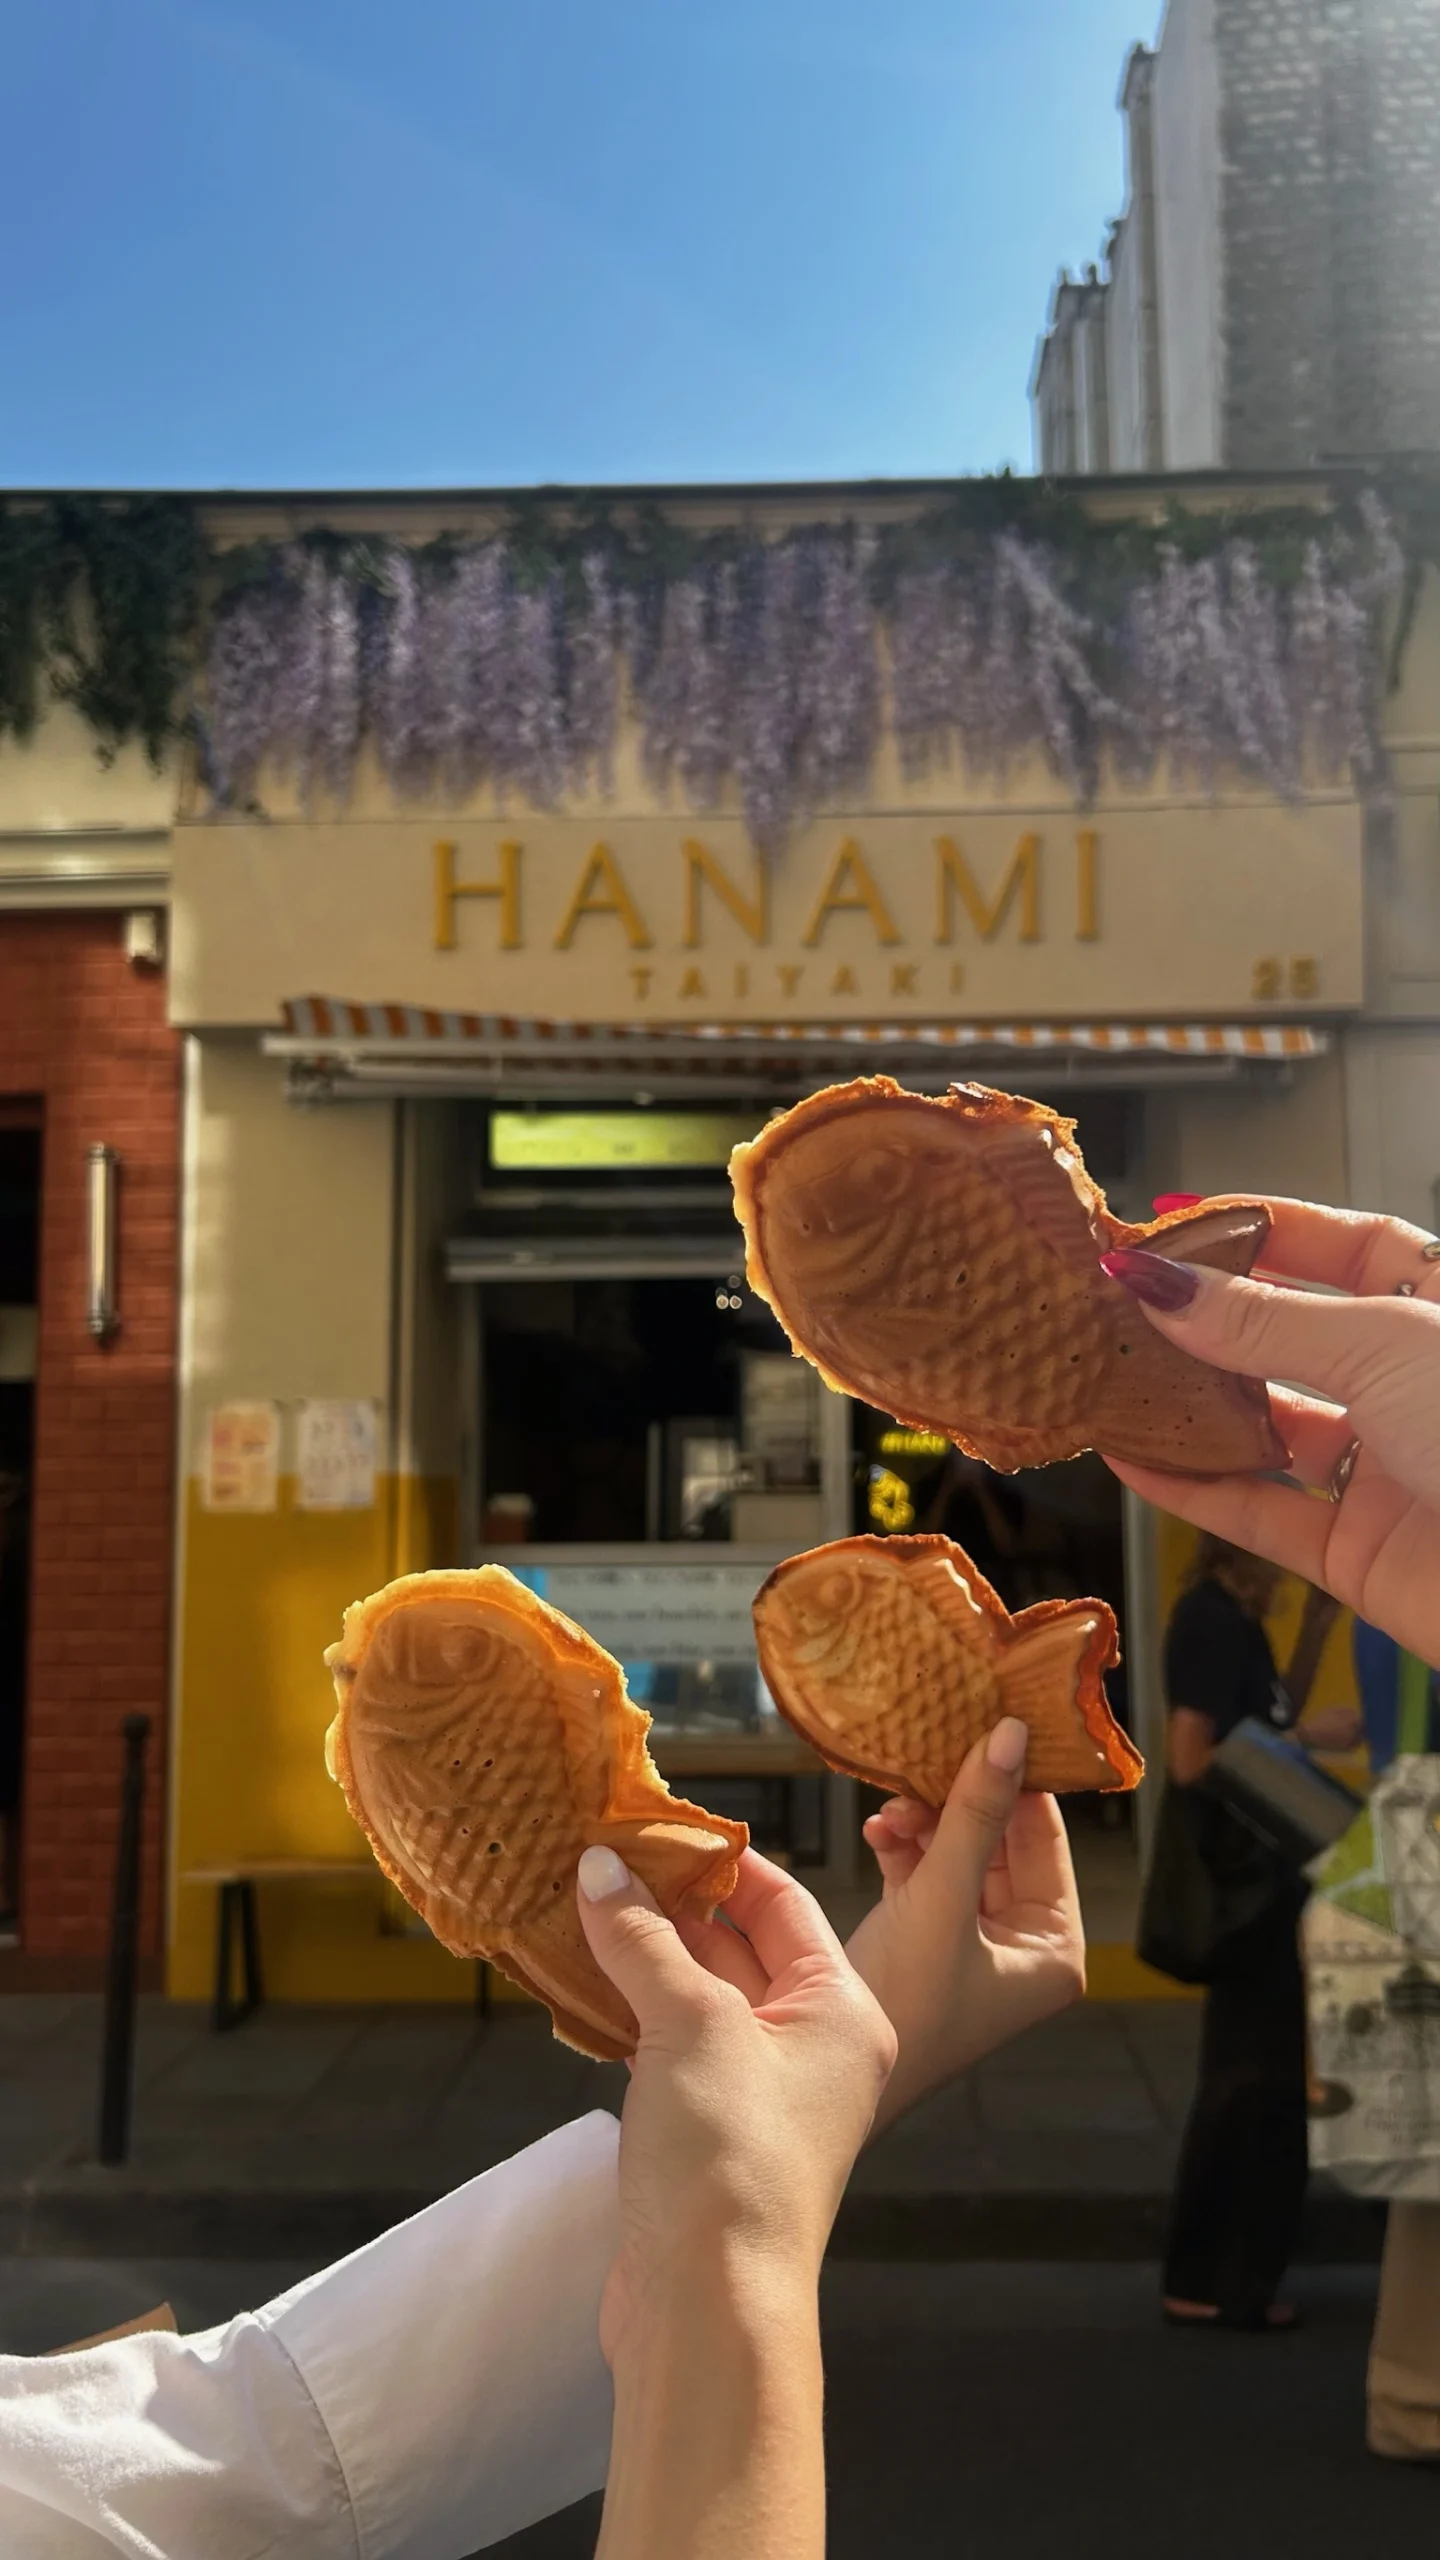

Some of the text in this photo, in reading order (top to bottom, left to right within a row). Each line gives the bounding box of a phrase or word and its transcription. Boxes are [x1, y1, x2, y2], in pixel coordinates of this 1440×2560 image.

[432, 831, 1104, 950] HANAMI
[628, 961, 967, 1001] TAIYAKI
[1252, 956, 1319, 1000] 25
